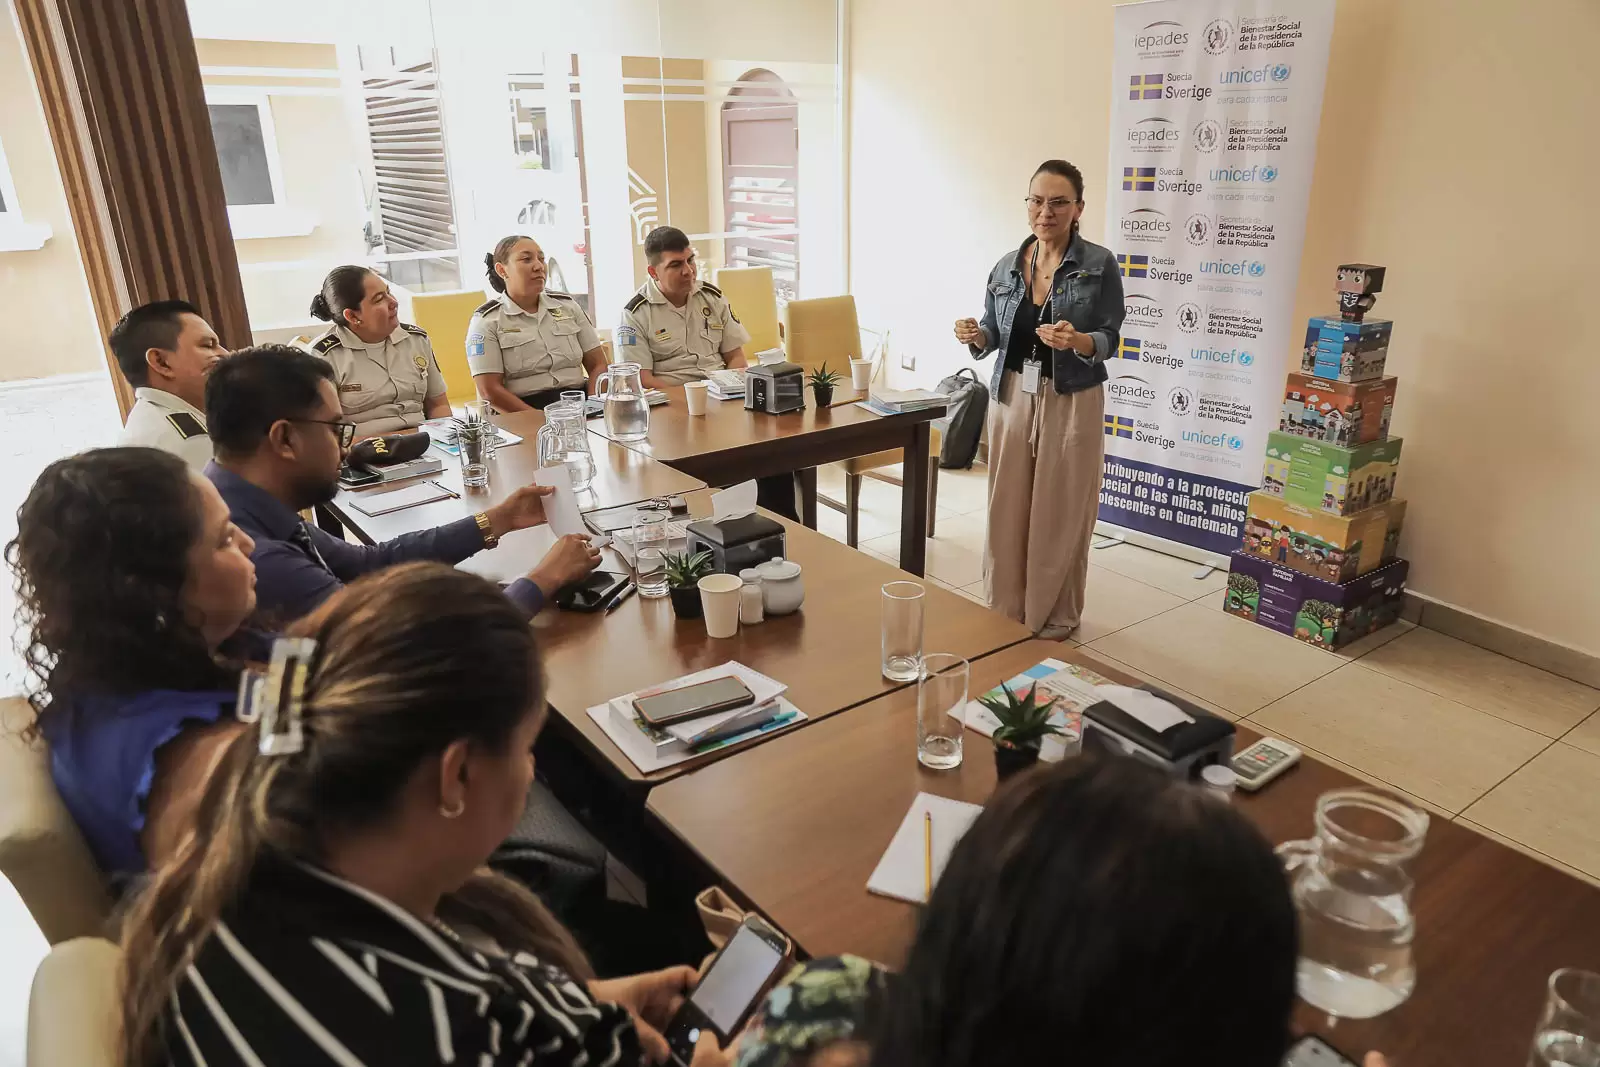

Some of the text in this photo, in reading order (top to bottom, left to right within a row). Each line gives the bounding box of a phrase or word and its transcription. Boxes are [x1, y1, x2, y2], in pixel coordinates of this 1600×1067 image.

[1240, 20, 1301, 34] Bienestar Social
[1134, 31, 1189, 51] iepades
[1239, 30, 1303, 42] de la Presidencia
[1238, 40, 1295, 51] de la República
[1166, 73, 1192, 82] Suecia
[1219, 63, 1271, 84] unicef
[1165, 85, 1212, 102] Sverige
[1127, 128, 1180, 145] iepades
[1229, 125, 1287, 135] Bienestar Social
[1227, 134, 1289, 143] de la Presidencia
[1227, 142, 1281, 152] de la República
[1159, 167, 1184, 176] Suecia
[1209, 163, 1258, 182] unicef
[1157, 179, 1203, 196] Sverige
[1120, 217, 1171, 234] iepades
[1218, 223, 1274, 233] Bienestar Social
[1216, 238, 1226, 246] de
[1235, 239, 1269, 248] República
[1228, 231, 1235, 239] la
[1236, 232, 1275, 241] Presidencia
[1151, 256, 1175, 266] Suecia
[1199, 257, 1248, 276] unicef
[1149, 267, 1193, 286] Sverige
[1208, 312, 1263, 325] Bienestar Social
[1207, 327, 1216, 335] de
[1225, 328, 1257, 340] República
[1226, 322, 1264, 333] Presidencia
[1143, 340, 1168, 351] Suecia
[1142, 351, 1184, 371] Sverige
[1190, 346, 1237, 364] unicef
[1108, 381, 1156, 400] iepades
[1199, 397, 1252, 412] Bienestar Social
[1197, 411, 1247, 425] de la República
[1208, 405, 1215, 413] la
[1215, 407, 1253, 420] Presidencia
[1136, 419, 1160, 431] Suecia
[1135, 430, 1176, 450] Sverige
[1182, 430, 1228, 448] unicef
[1167, 478, 1175, 490] a
[1178, 478, 1189, 492] la
[1134, 485, 1148, 499] de
[1151, 488, 1169, 504] las
[1171, 494, 1207, 515] niñas,
[1211, 502, 1246, 523] niños
[1159, 507, 1173, 522] en
[1176, 510, 1238, 538] Guatemala
